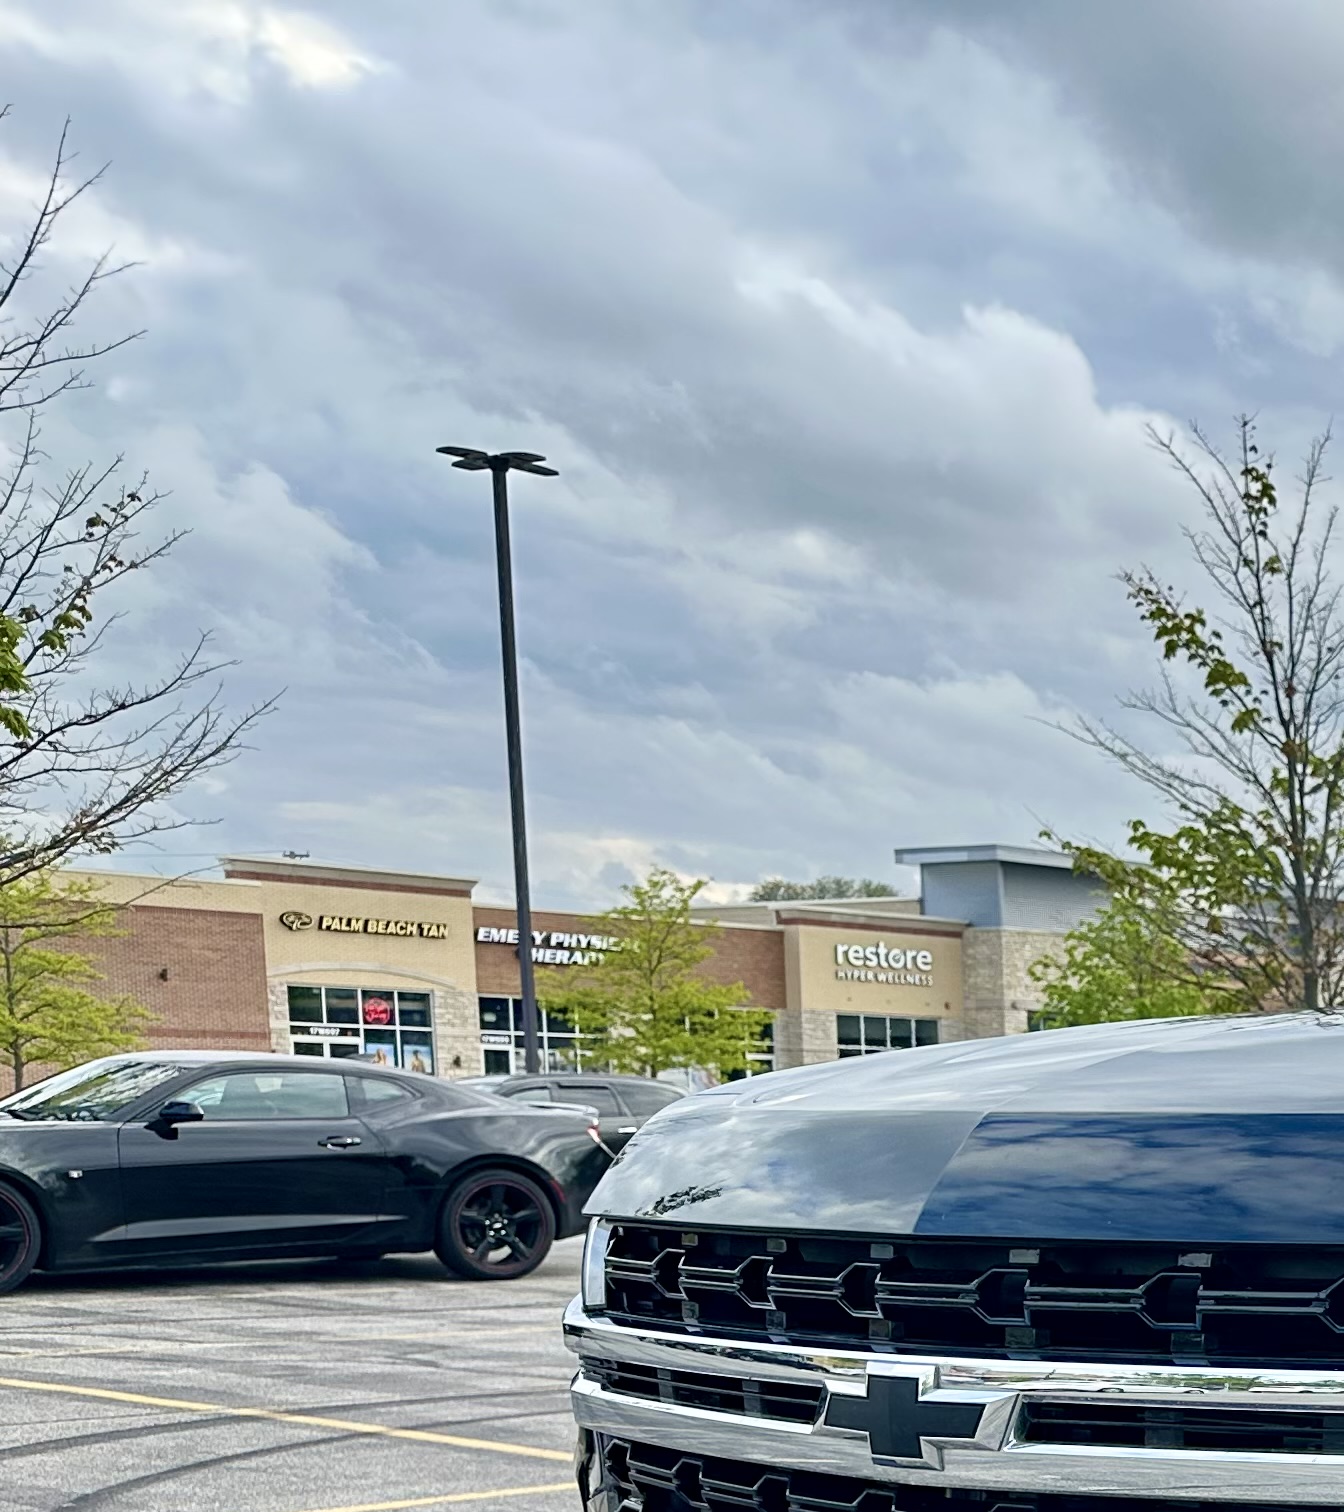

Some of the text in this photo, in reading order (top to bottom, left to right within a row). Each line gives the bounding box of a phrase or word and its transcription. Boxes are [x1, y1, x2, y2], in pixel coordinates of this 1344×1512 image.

[321, 916, 448, 939] PALM BEACH TAN
[477, 927, 547, 947] EMEY
[836, 941, 933, 972] restore
[837, 969, 934, 987] HYPER WELLNESS
